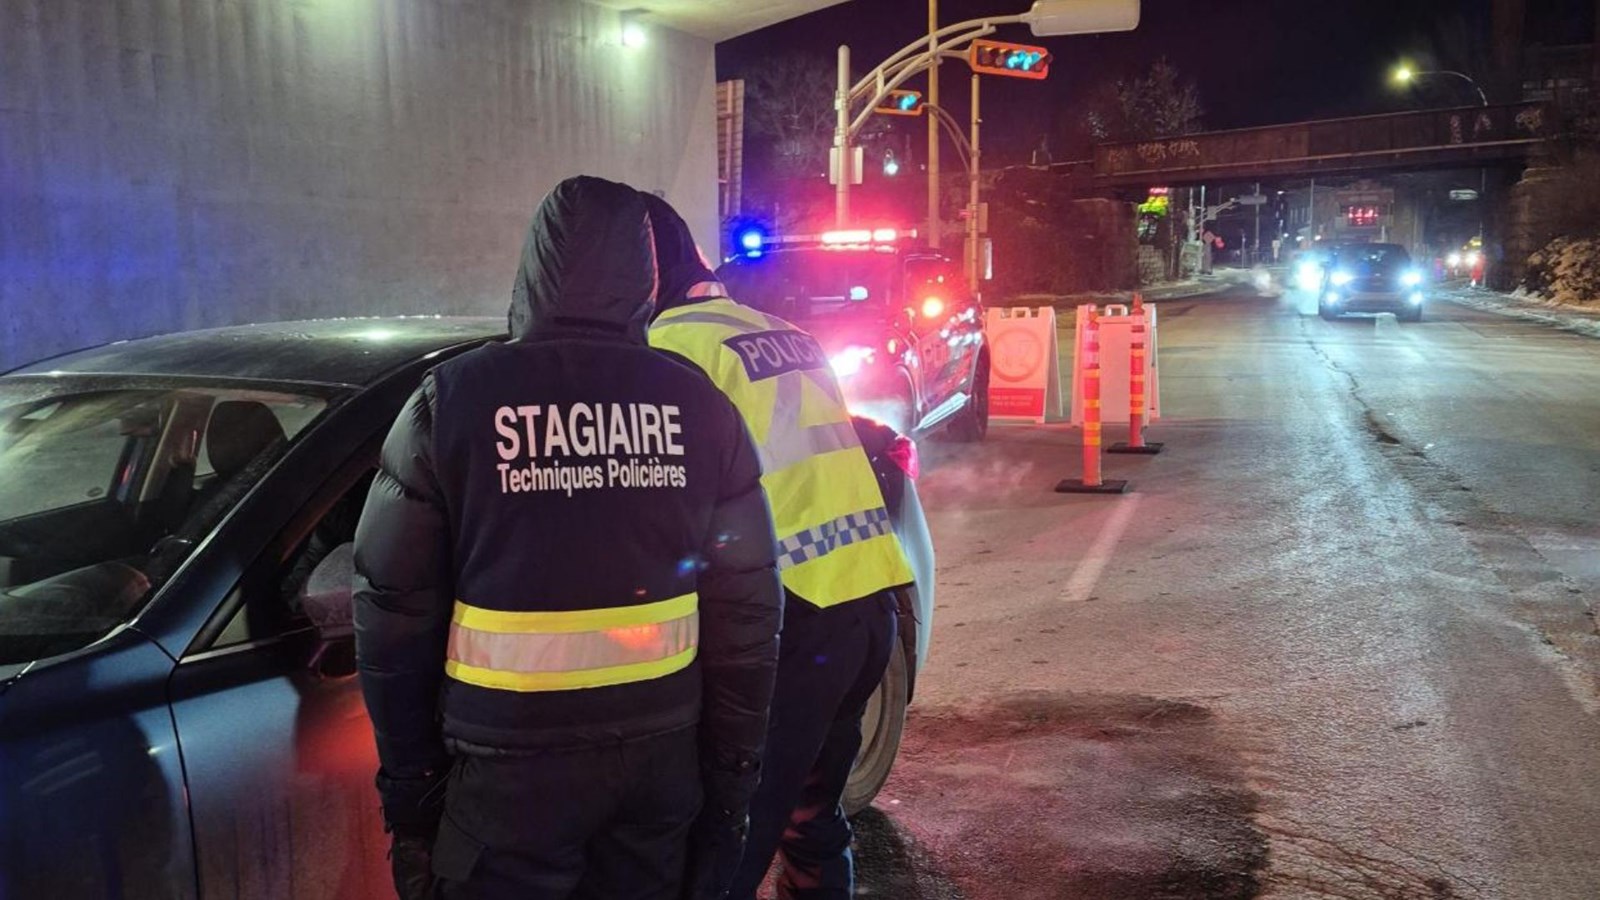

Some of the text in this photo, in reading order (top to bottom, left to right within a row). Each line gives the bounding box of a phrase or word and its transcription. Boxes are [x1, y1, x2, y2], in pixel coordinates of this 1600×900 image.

[494, 402, 685, 460] STAGIAIRE
[497, 457, 687, 497] Techniques Policières
